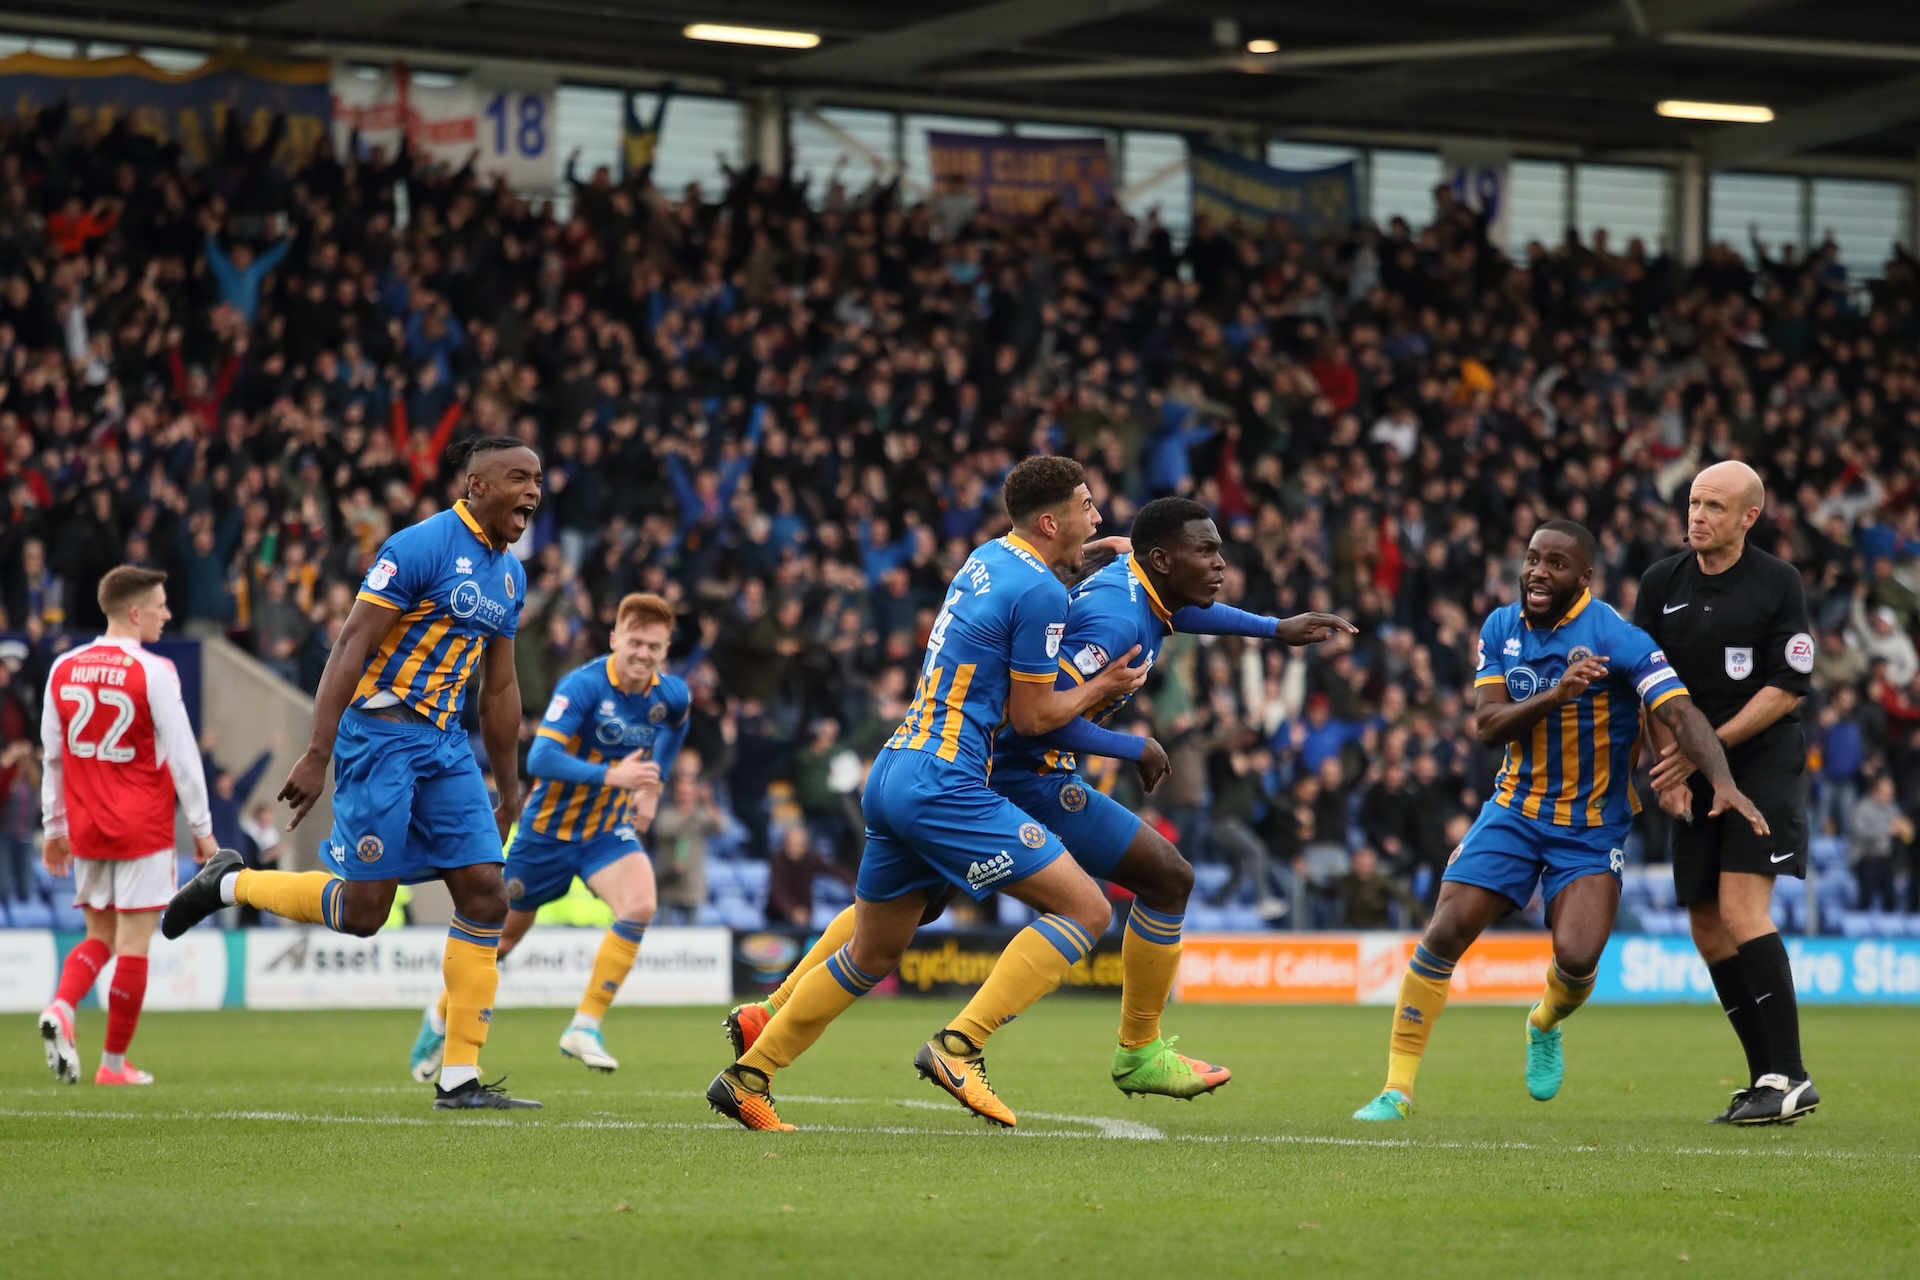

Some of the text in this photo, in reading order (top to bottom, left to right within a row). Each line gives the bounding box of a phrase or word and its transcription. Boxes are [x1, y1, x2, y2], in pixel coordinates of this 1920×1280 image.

[484, 93, 545, 159] 18
[953, 557, 991, 597] FREY
[460, 592, 507, 617] THE ENERGY
[926, 588, 963, 677] 4
[1095, 652, 1107, 667] BET
[1791, 641, 1813, 658] EA
[70, 665, 128, 687] HUNTER
[1510, 679, 1530, 691] THE
[1538, 677, 1560, 688] ENE
[60, 684, 136, 763] 22
[966, 849, 1010, 879] Asset
[972, 869, 1012, 890] Construction
[263, 927, 381, 973] Asset
